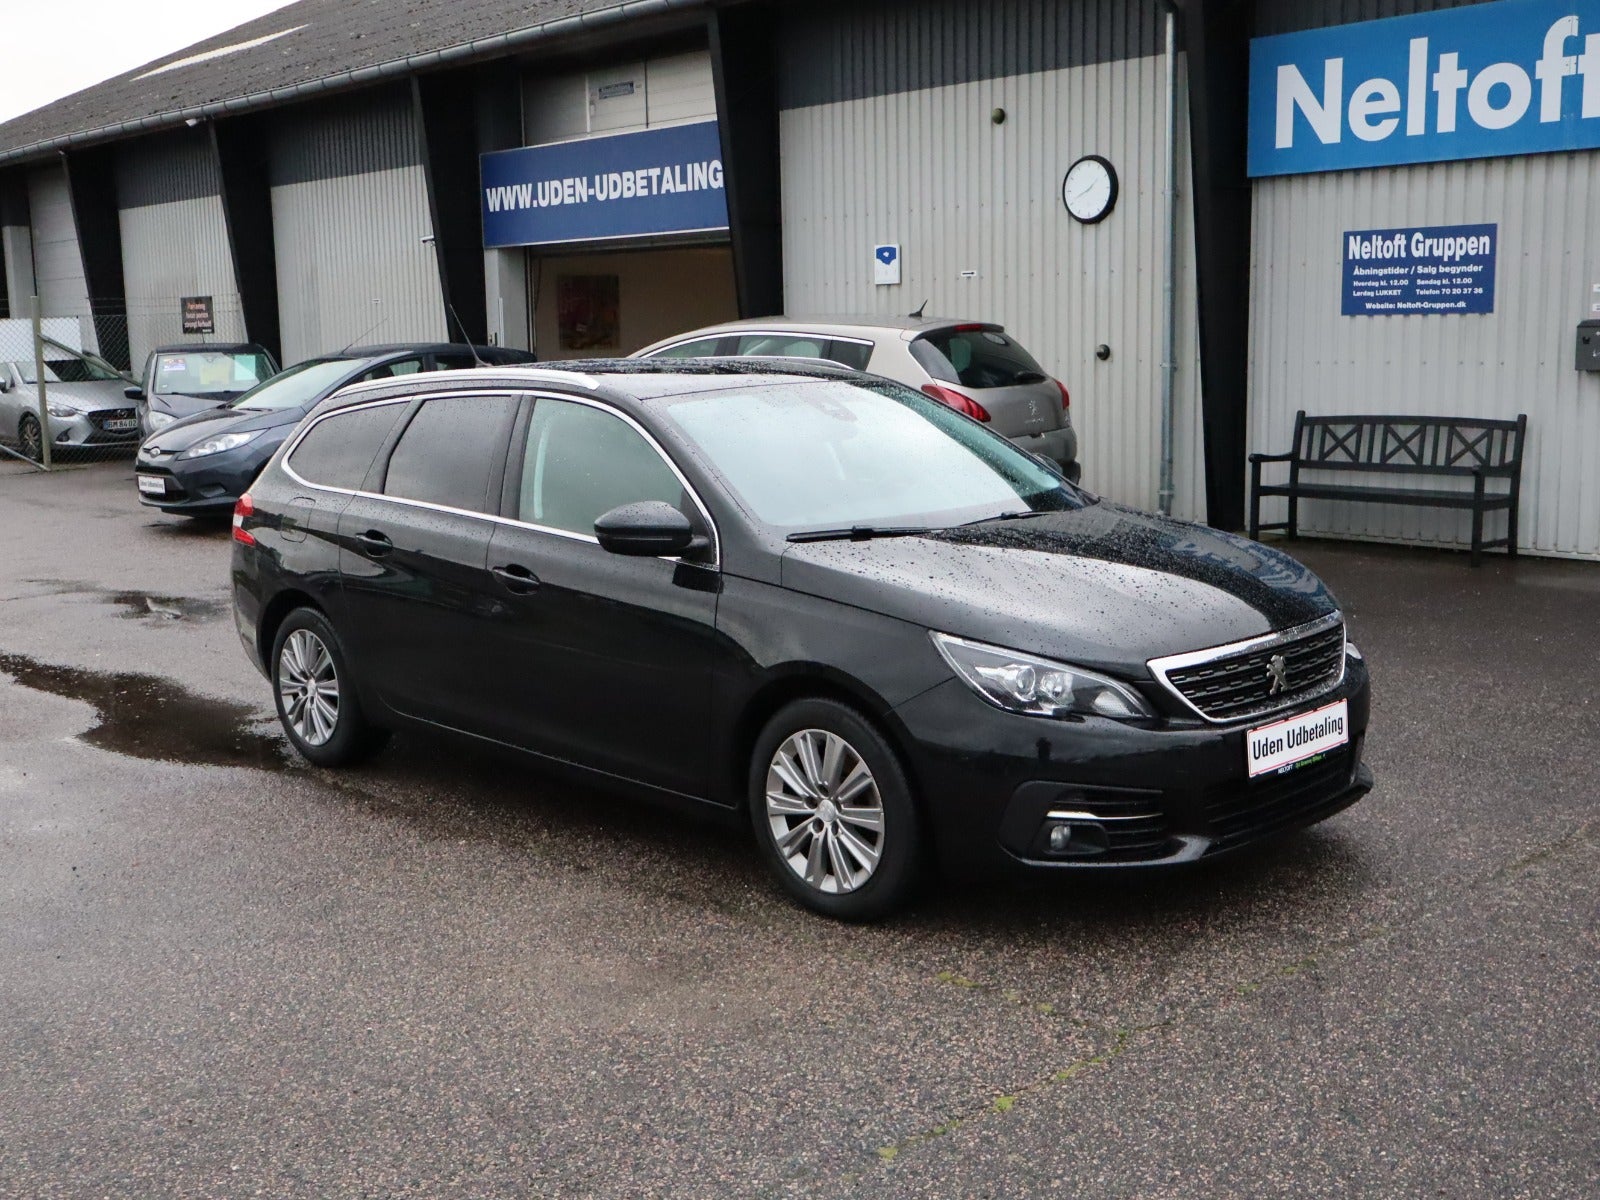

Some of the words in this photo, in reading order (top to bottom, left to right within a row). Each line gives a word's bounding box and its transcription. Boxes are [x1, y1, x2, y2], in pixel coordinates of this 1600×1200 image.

[486, 159, 724, 212] WWW.UDEN-UDBETALING
[1348, 233, 1407, 260] Neltoft
[1411, 232, 1491, 262] Gruppen
[1353, 265, 1409, 276] Åbningstider
[1410, 265, 1415, 275] /
[1416, 265, 1437, 275] Salg
[1439, 264, 1484, 274] begynder
[1416, 288, 1440, 296] Telefon
[1365, 302, 1396, 310] Website:
[1252, 736, 1283, 760] Uden
[1287, 716, 1344, 750] Udbetaling
